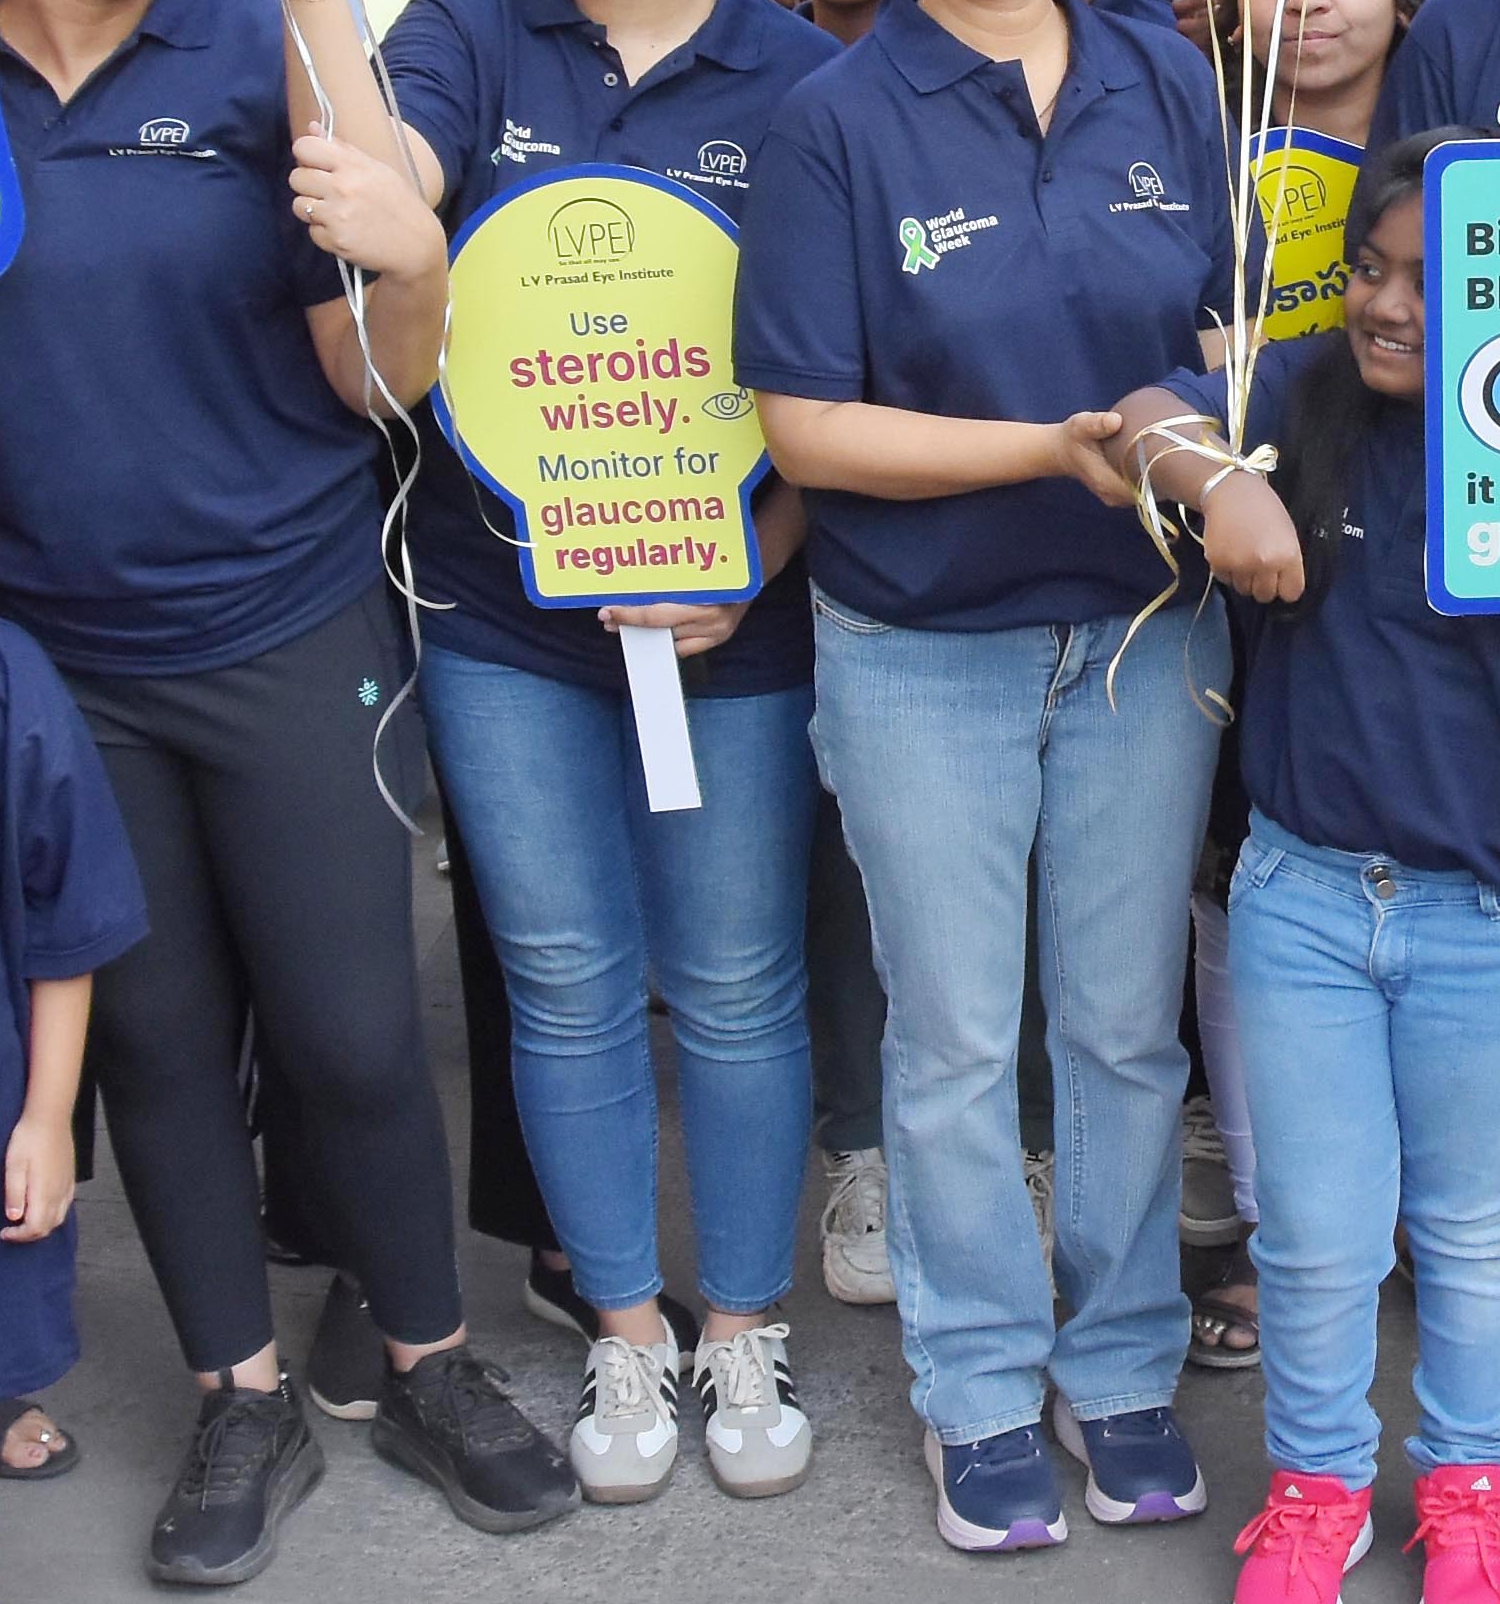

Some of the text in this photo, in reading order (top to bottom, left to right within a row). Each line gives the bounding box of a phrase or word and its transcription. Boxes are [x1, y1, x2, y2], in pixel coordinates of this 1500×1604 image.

[140, 127, 188, 143] LVPEI
[700, 151, 745, 173] LVPEI
[925, 207, 965, 231] World
[931, 215, 999, 243] Glaucoma
[554, 222, 633, 258] LVPEI
[933, 234, 971, 254] Week
[1291, 229, 1312, 241] Eye
[521, 268, 674, 287] L V Prasad Eye Institute
[569, 312, 629, 336] Use
[509, 338, 711, 388] steroids
[540, 391, 691, 435] wisely.
[537, 446, 720, 483] Monitor for
[1466, 471, 1495, 505] it
[540, 496, 725, 537] glaucoma
[555, 536, 728, 576] regularly.
